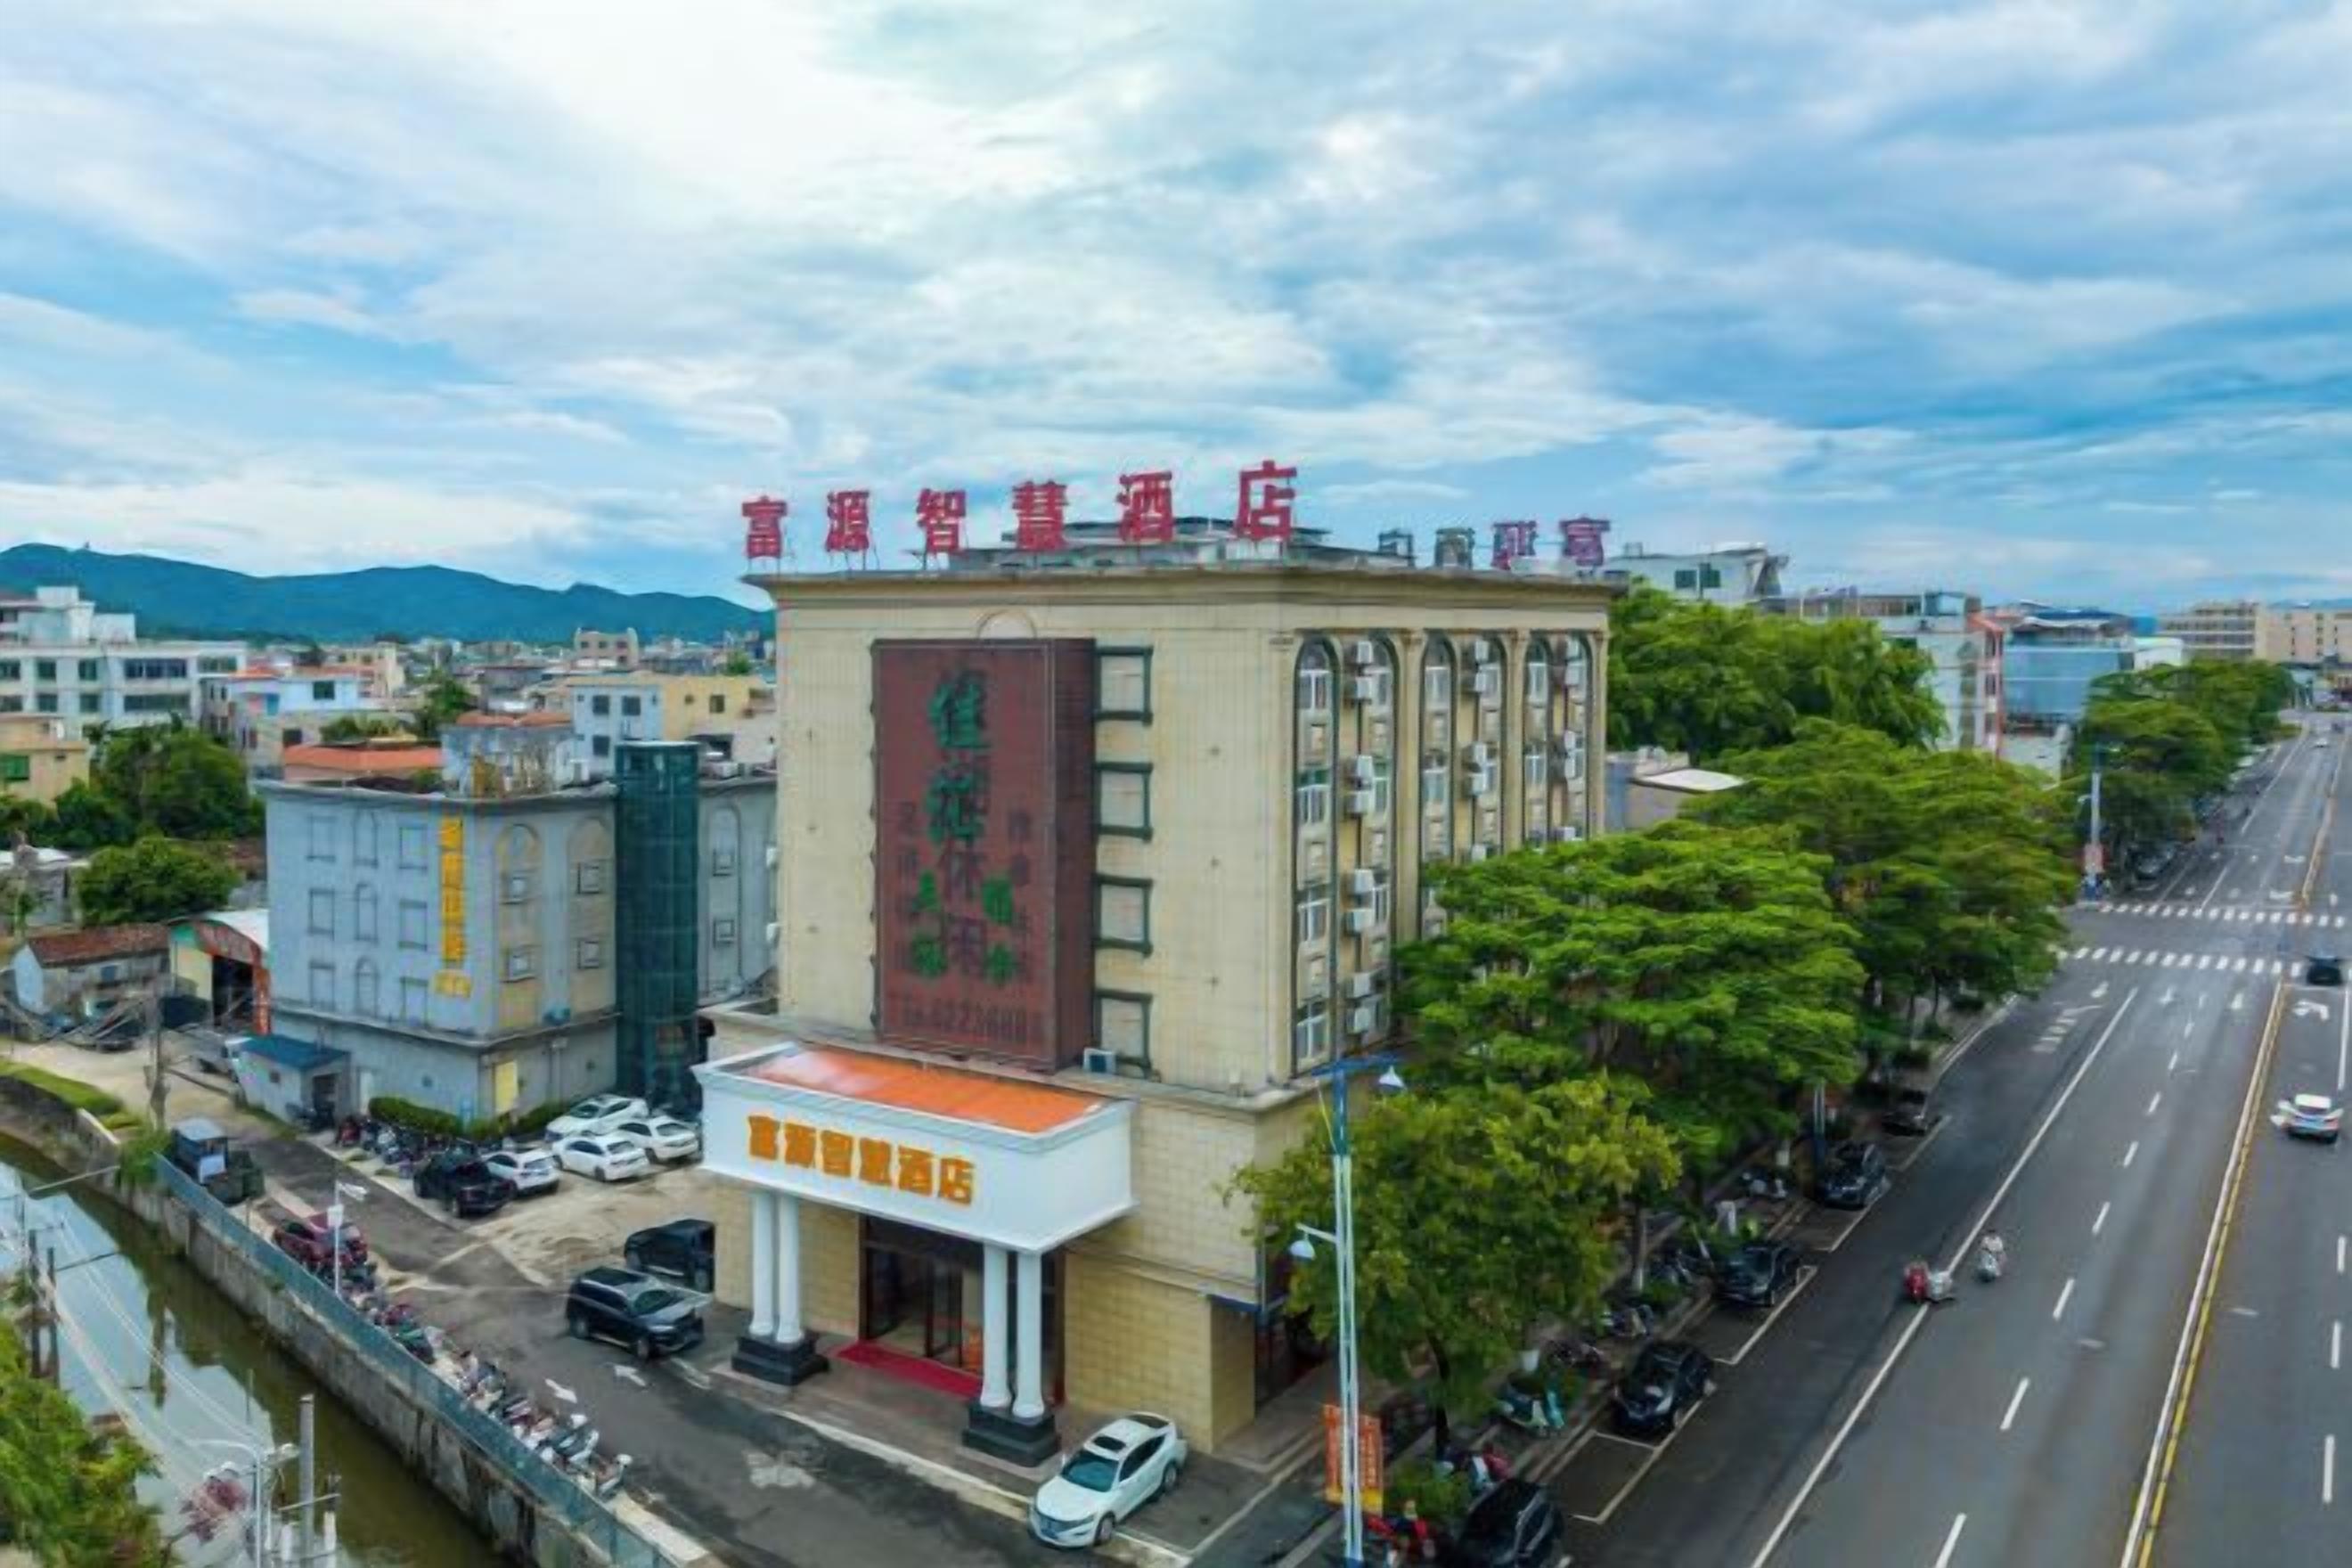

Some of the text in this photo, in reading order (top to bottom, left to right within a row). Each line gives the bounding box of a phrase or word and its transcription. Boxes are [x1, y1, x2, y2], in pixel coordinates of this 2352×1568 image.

[742, 460, 1297, 558] 富源智慧酒店
